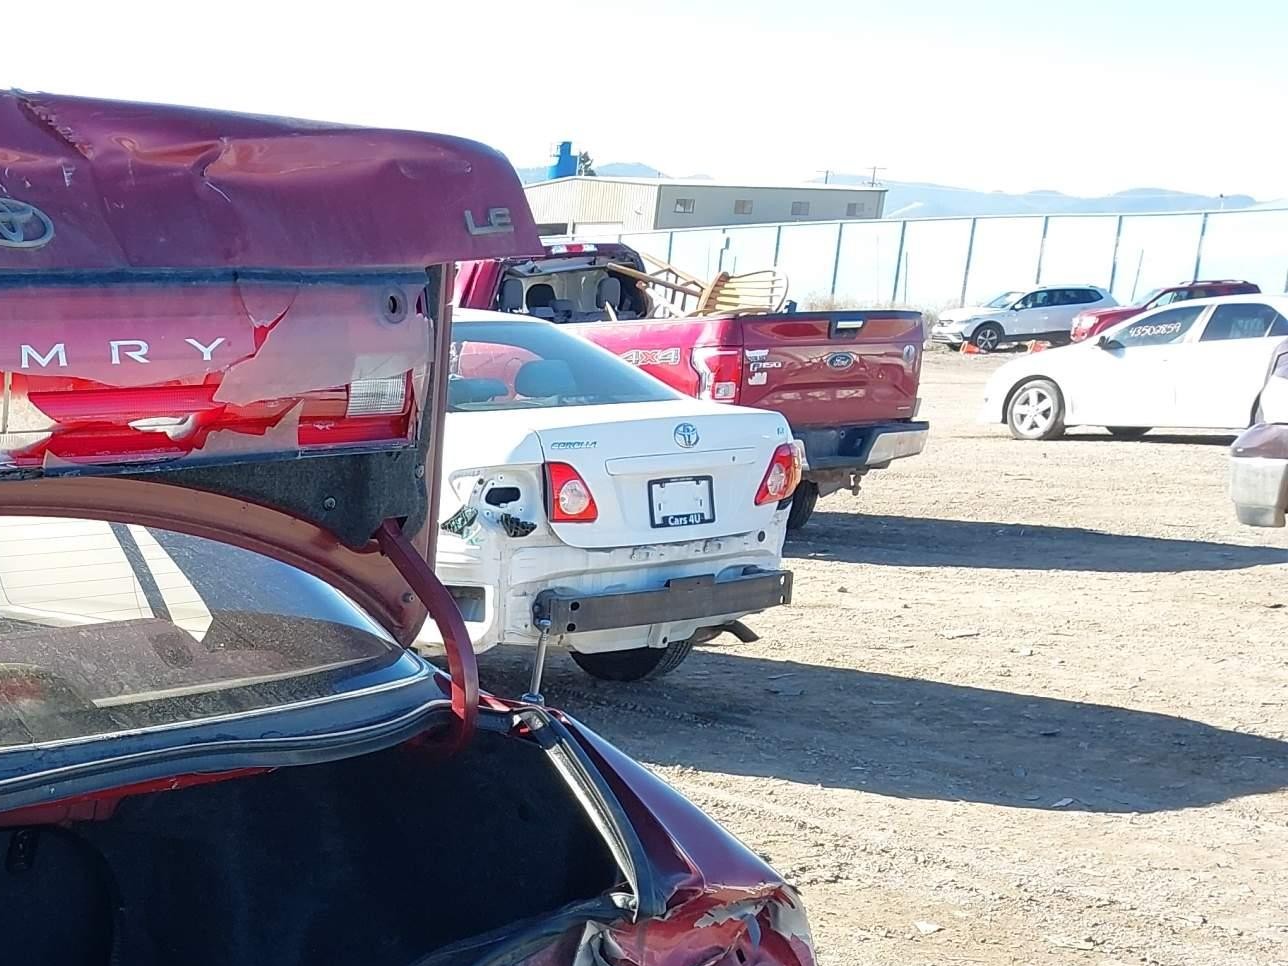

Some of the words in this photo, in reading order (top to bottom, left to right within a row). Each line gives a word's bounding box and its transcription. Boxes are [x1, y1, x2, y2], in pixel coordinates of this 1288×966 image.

[464, 207, 514, 235] LE
[668, 515, 688, 525] Cars
[689, 513, 701, 524] 4U
